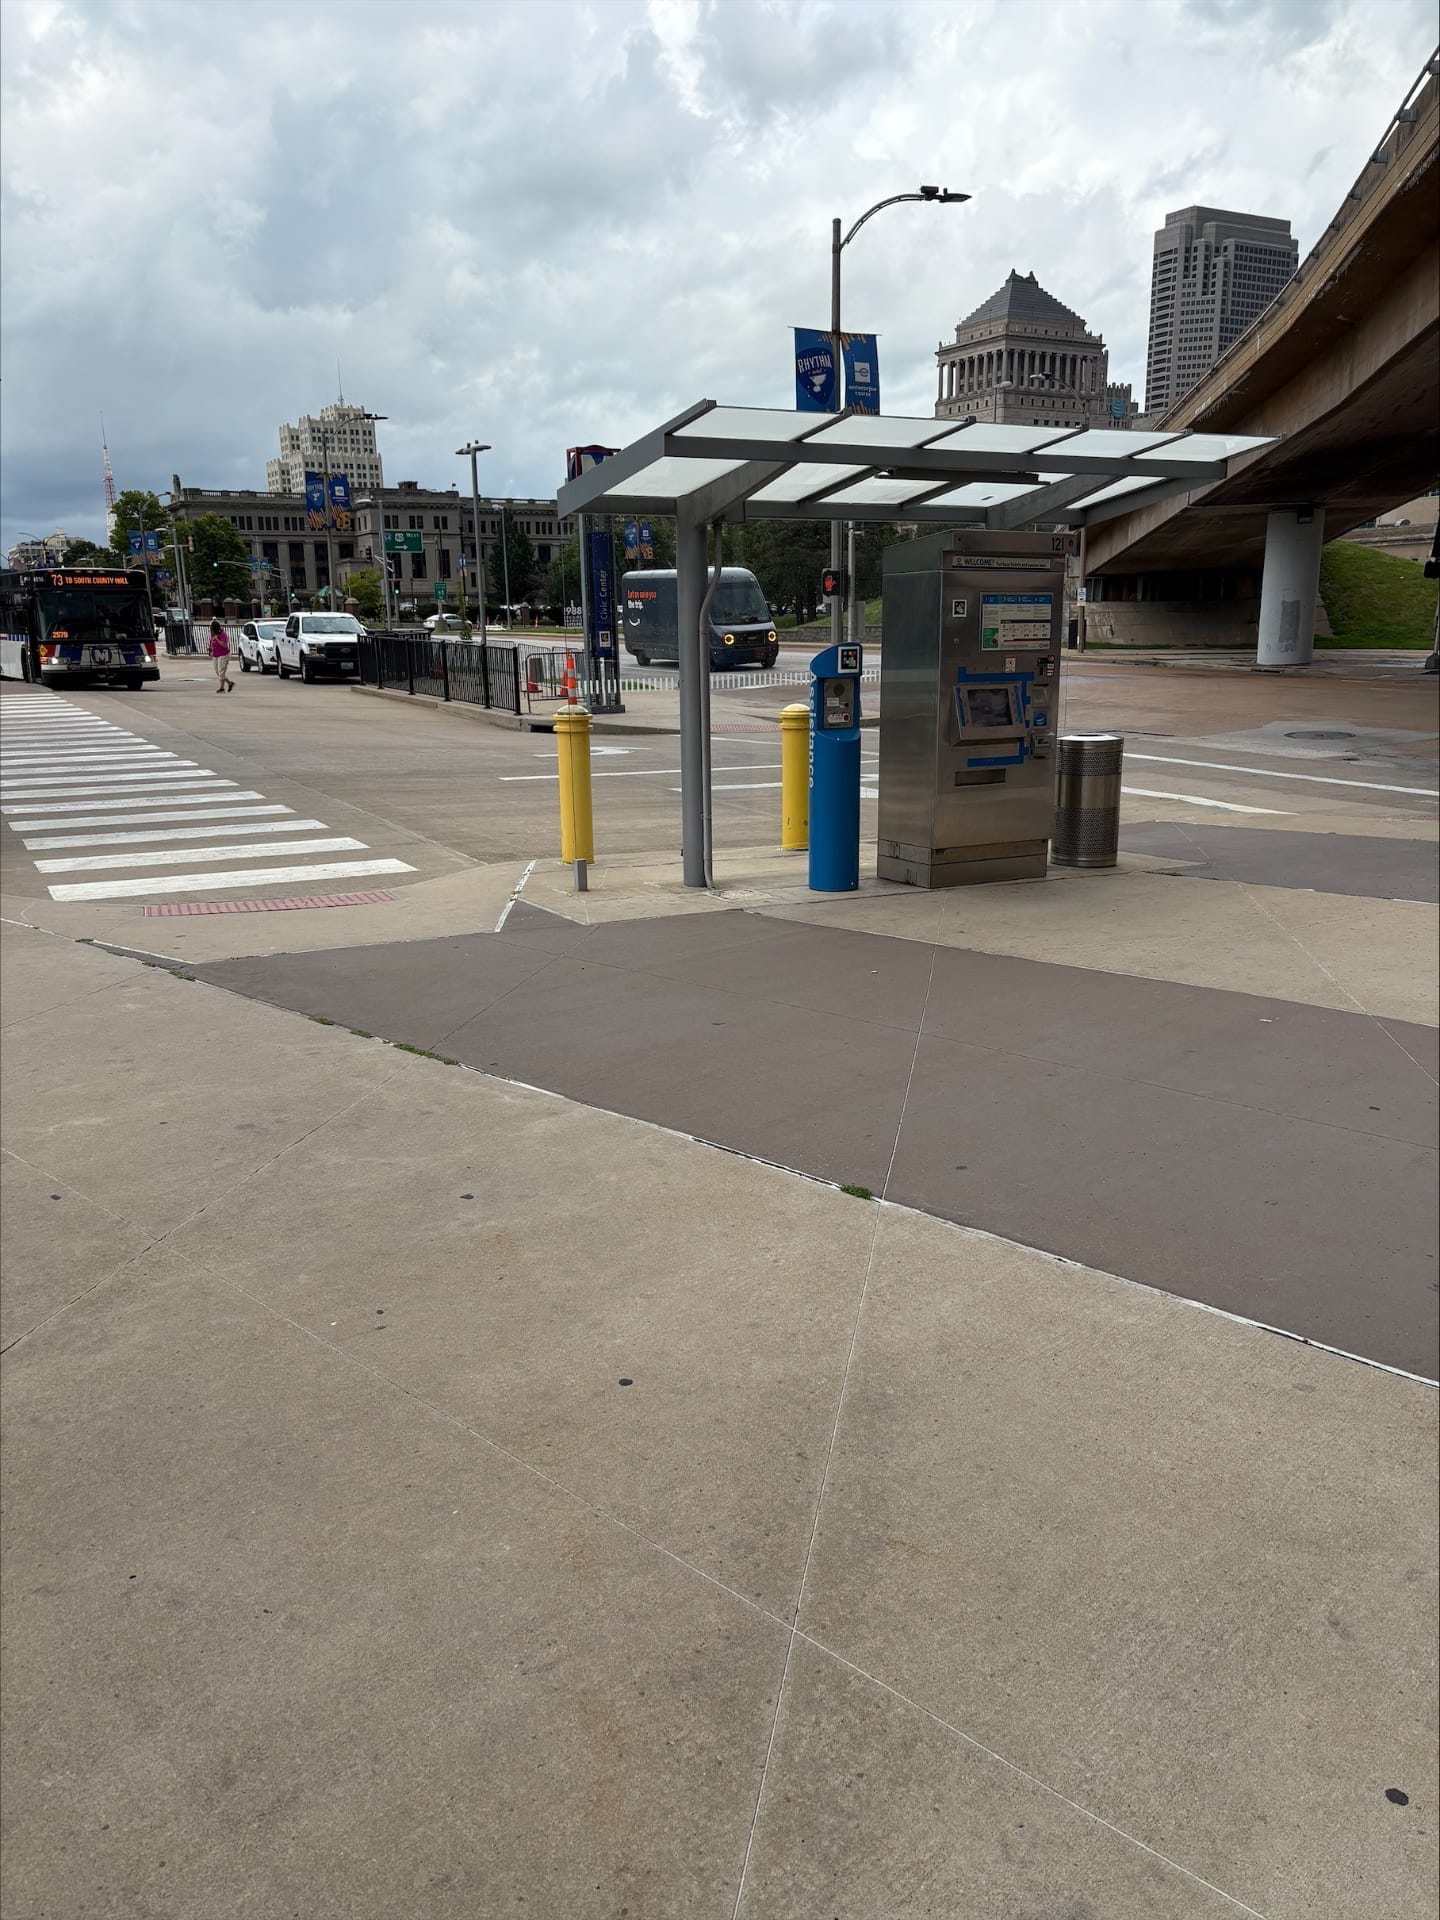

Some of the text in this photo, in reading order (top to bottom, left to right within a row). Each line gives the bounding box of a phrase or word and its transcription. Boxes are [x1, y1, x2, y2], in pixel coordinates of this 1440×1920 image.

[797, 354, 832, 374] RHYTHM
[51, 574, 64, 586] 73
[74, 577, 91, 585] SOUTH
[93, 577, 114, 585] COUNTY
[600, 570, 608, 620] Civic Center
